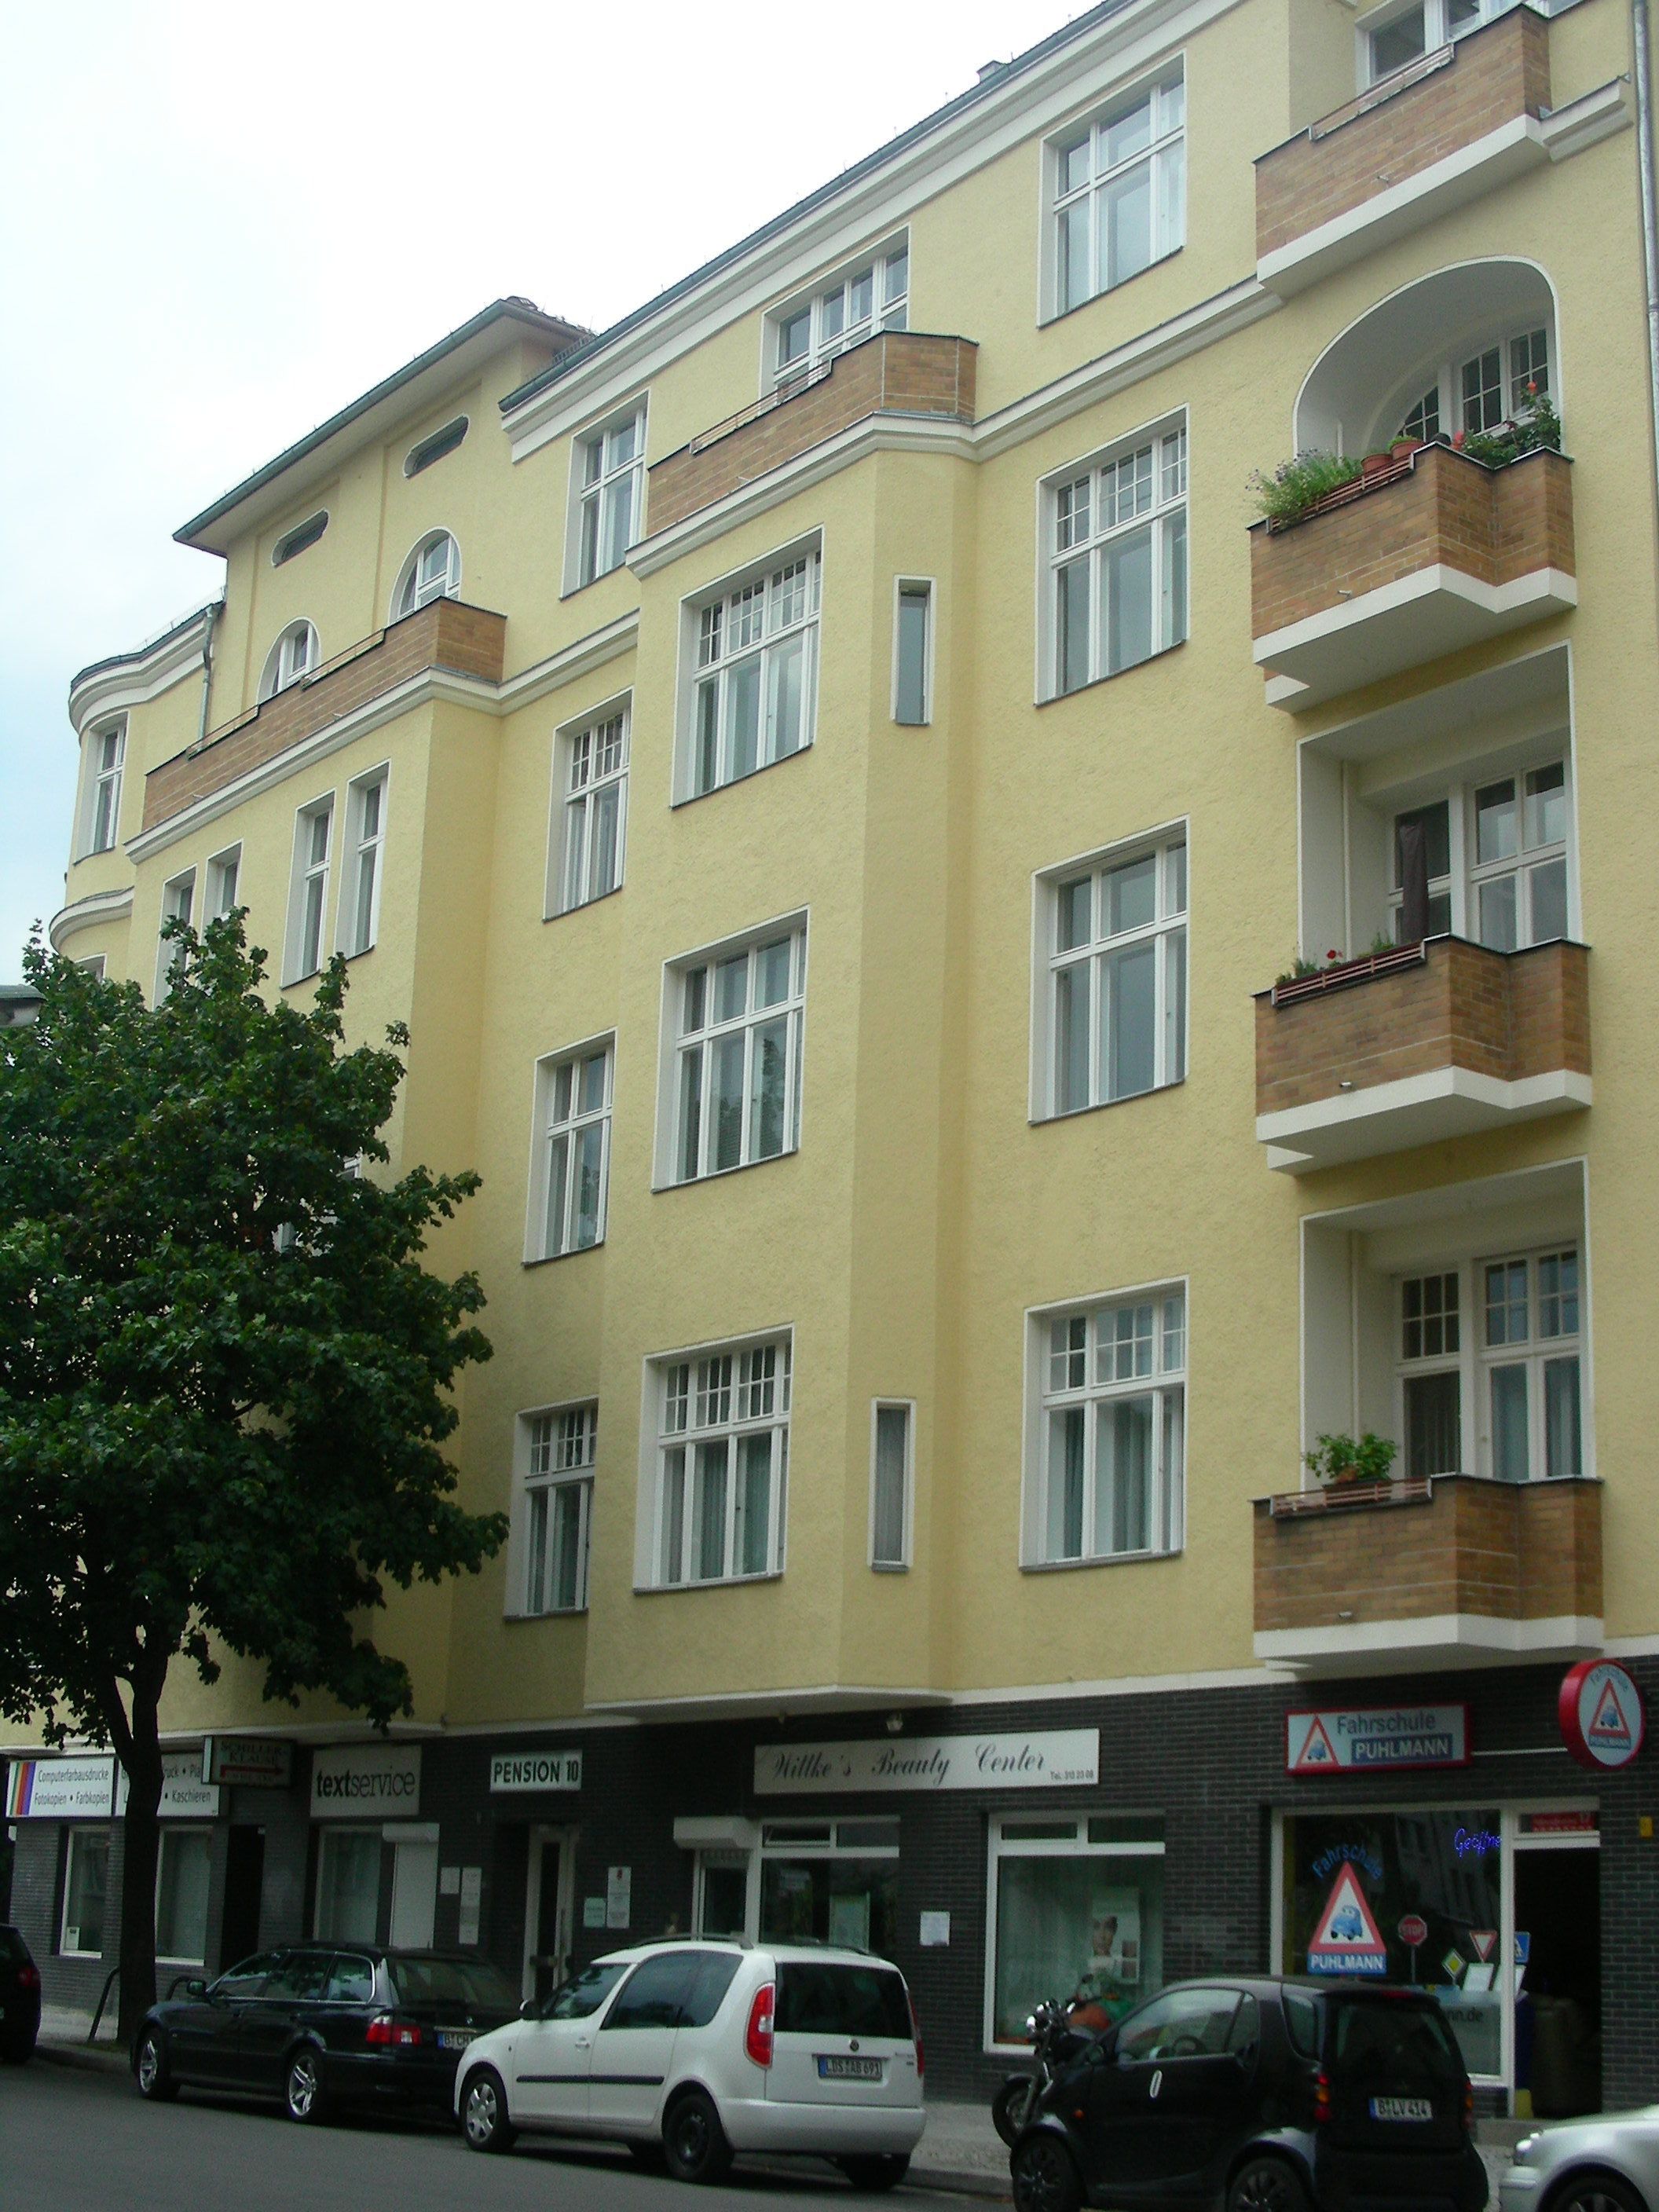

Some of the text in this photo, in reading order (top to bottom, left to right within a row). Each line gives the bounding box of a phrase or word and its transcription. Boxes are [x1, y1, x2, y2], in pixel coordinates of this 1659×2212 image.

[1337, 1712, 1436, 1735] Fahrschule
[1354, 1738, 1449, 1760] PUHLMANN
[39, 1768, 110, 1785] Computerfarbausdrucke
[494, 1760, 579, 1784] PENSION 10
[872, 1749, 950, 1788] Beauty
[975, 1743, 1045, 1773] Center
[317, 1765, 416, 1798] textservice
[35, 1793, 67, 1807] Fotokopien
[76, 1791, 110, 1807] Farbkopien
[172, 1790, 211, 1804] Kaschieren
[1311, 1843, 1384, 1880] Fahrschule
[1310, 1954, 1385, 1972] PUHLMANN
